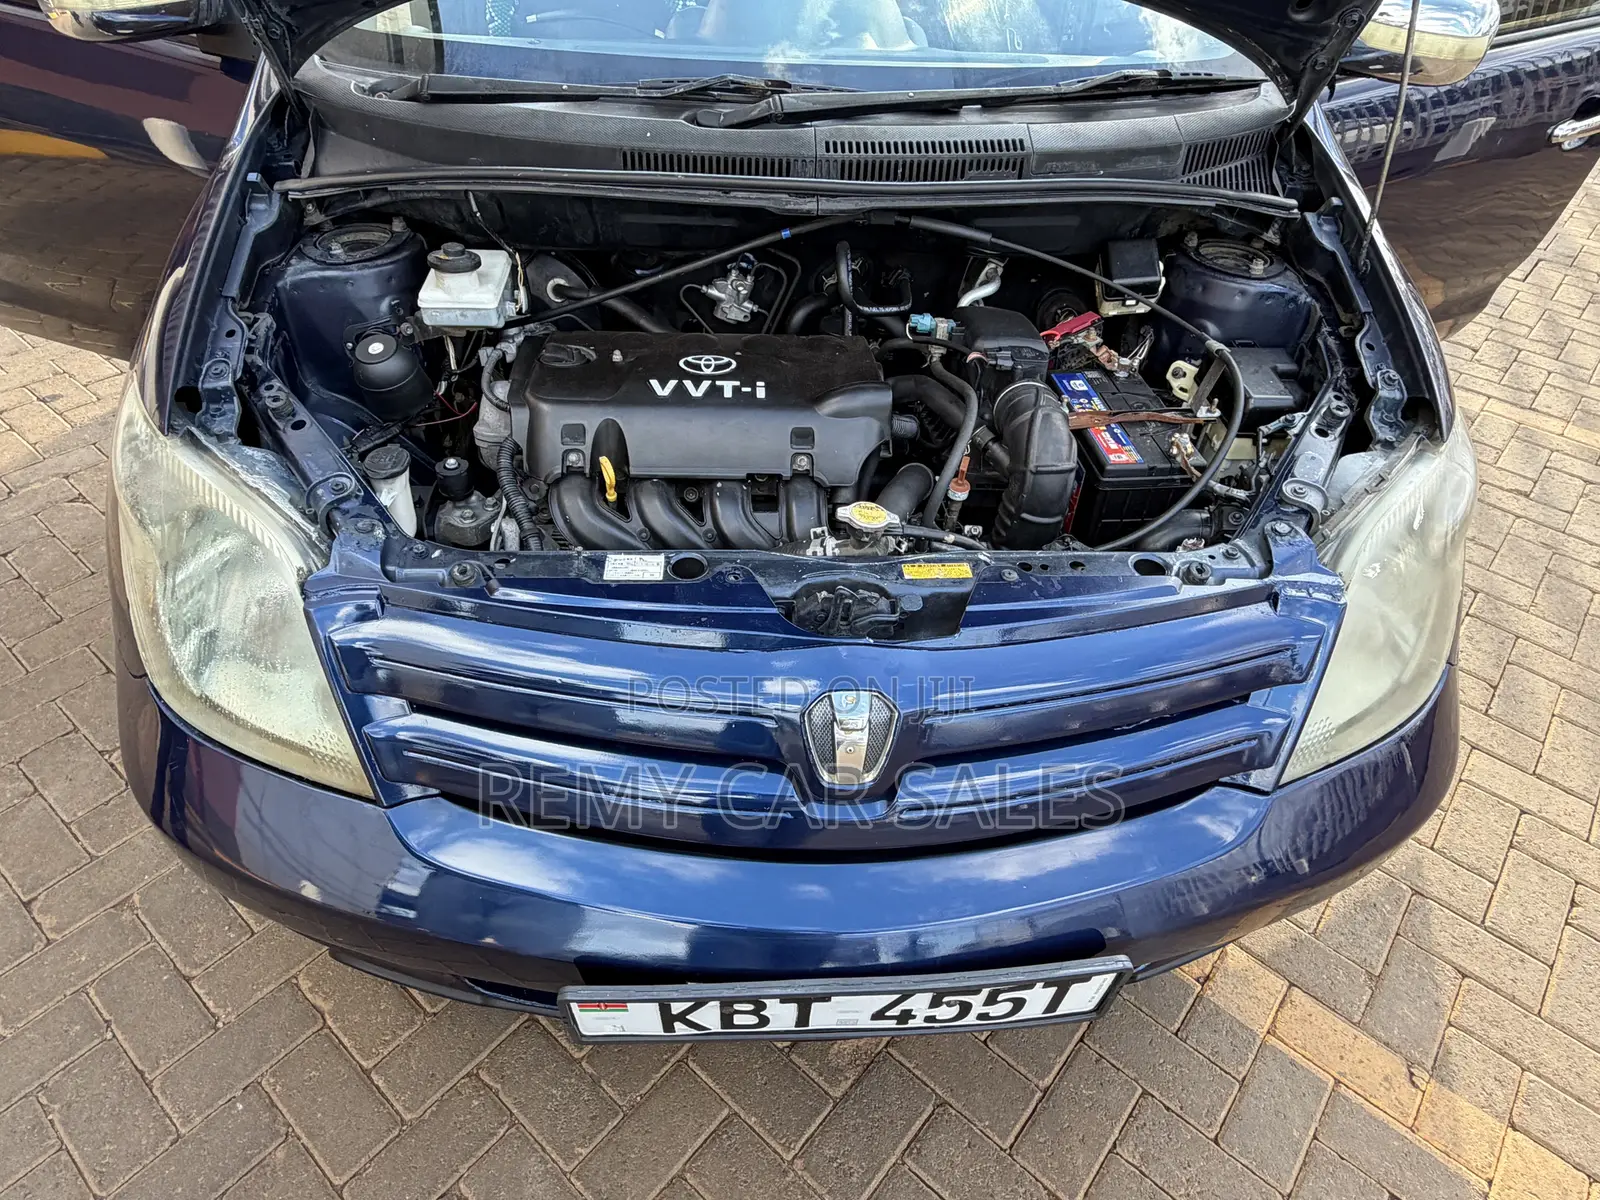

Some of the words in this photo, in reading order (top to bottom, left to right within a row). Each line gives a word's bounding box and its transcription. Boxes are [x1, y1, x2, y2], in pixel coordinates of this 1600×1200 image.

[648, 380, 766, 399] VVT-i
[658, 996, 832, 1034] KBT
[870, 978, 1093, 1026] 455T
